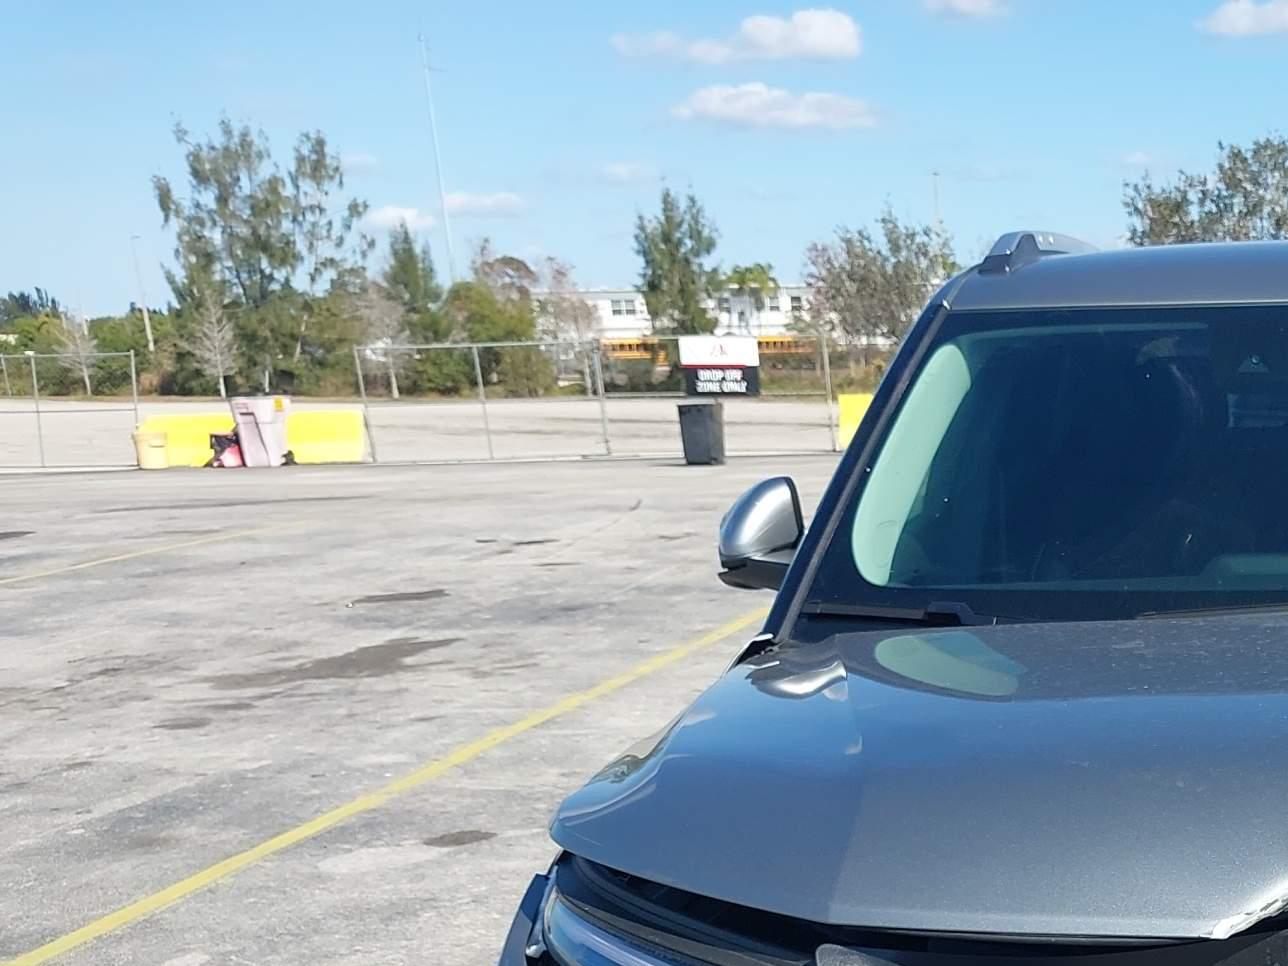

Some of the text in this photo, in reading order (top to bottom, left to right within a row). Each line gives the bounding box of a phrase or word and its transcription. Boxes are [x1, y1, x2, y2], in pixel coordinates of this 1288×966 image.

[696, 368, 724, 381] DROP
[695, 380, 747, 393] ZONE ONLY
